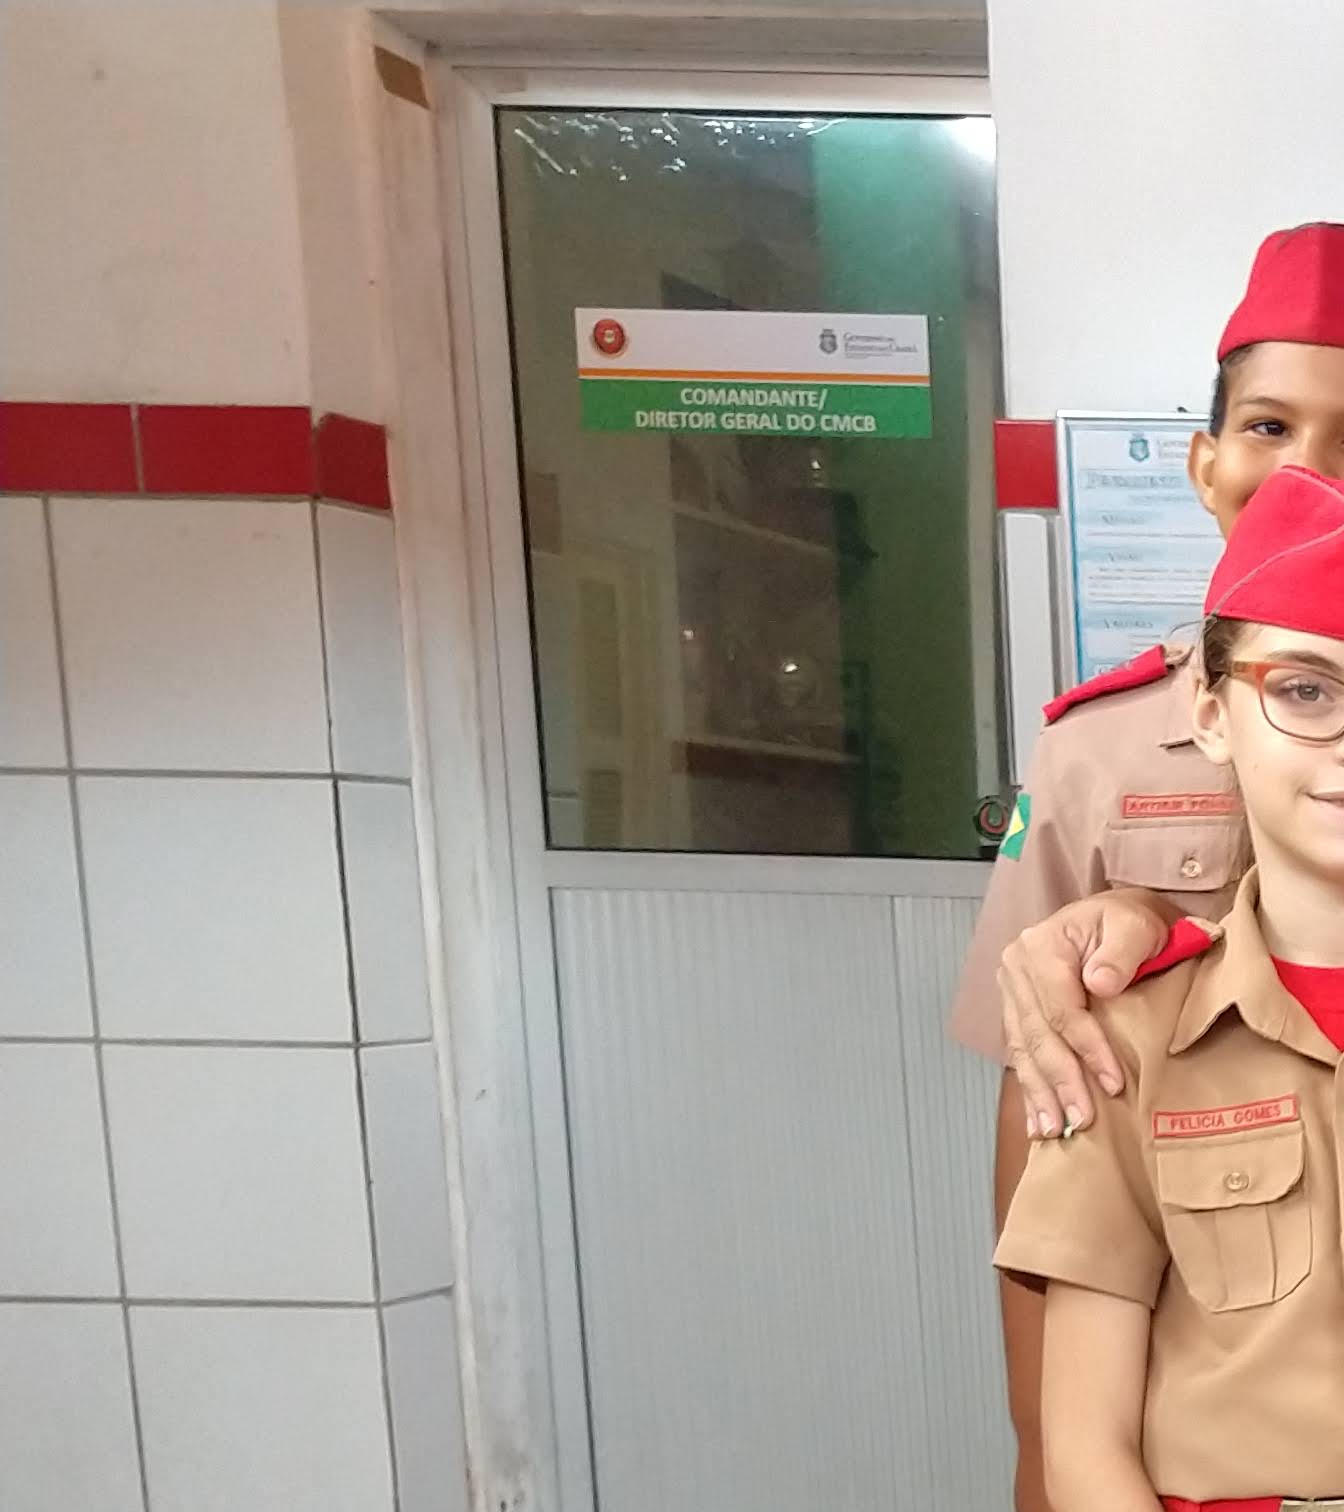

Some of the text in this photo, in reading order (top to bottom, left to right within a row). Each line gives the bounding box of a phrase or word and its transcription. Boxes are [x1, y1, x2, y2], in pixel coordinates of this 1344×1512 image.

[680, 388, 828, 409] COMANDANTE/
[635, 411, 877, 433] DIRETOR GERAL DO CMCB
[1233, 1104, 1282, 1125] GOMES
